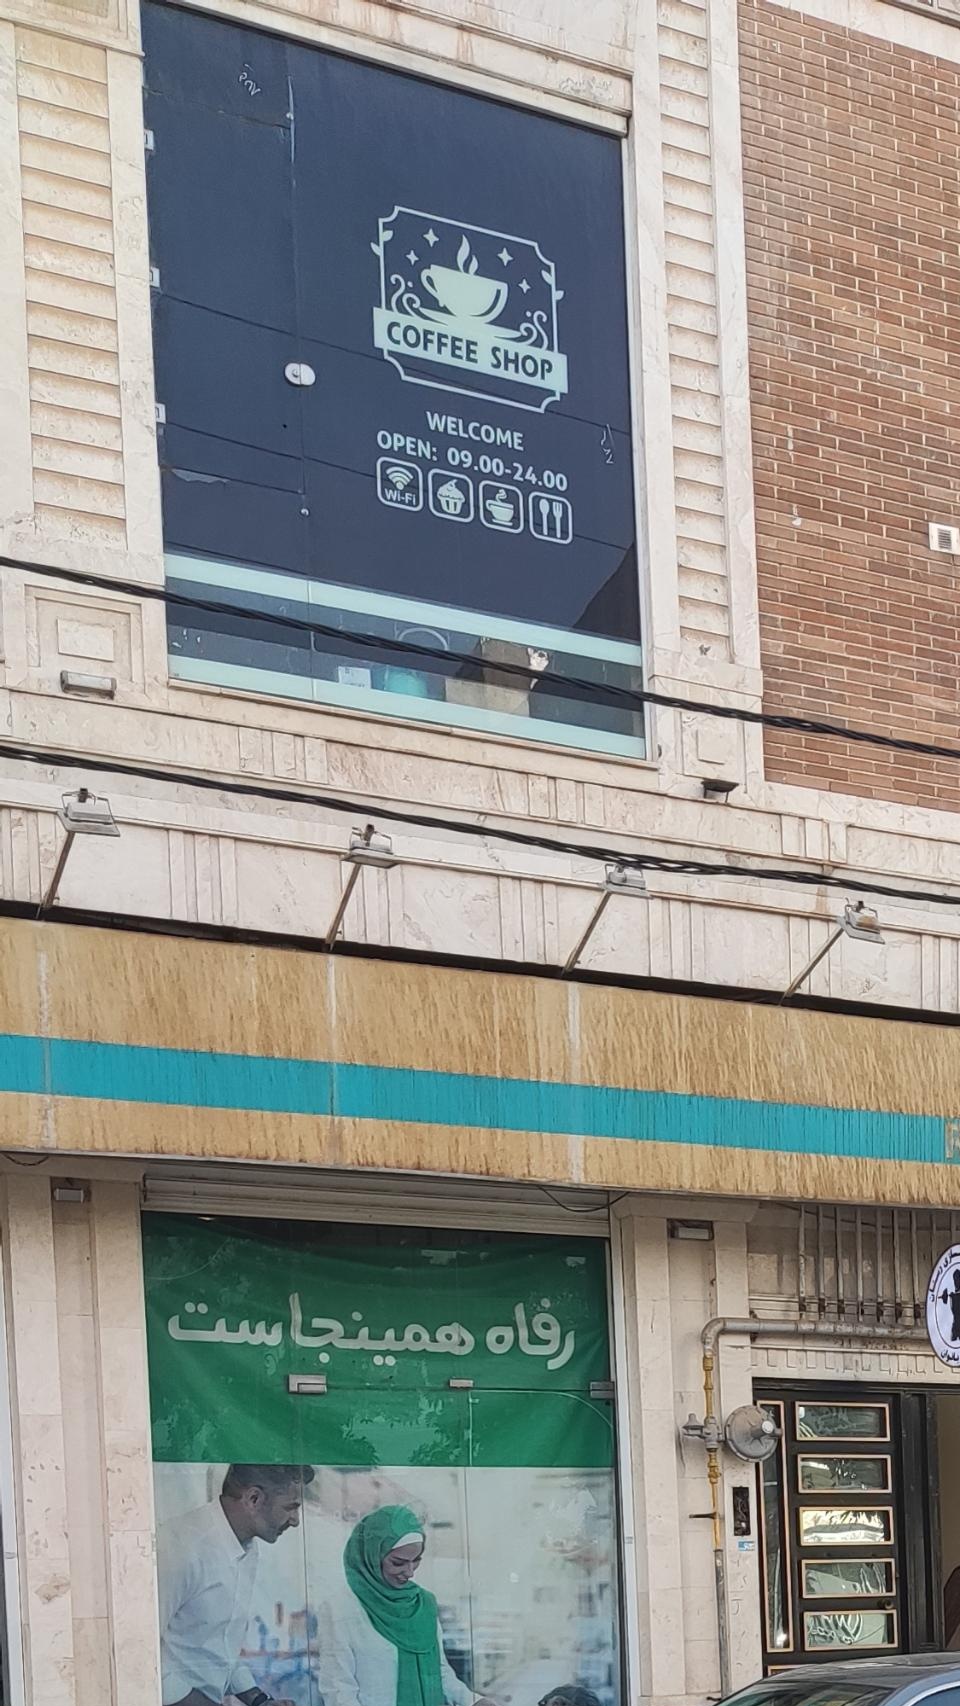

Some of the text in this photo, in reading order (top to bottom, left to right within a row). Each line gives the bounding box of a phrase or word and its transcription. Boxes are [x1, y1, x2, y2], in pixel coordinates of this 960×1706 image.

[386, 320, 554, 382] COFFEE SHOP
[376, 430, 568, 492] OPEN: 09.00-24.00
[426, 410, 524, 451] WELCOME
[384, 488, 416, 506] Wi-Fi
[167, 1292, 576, 1371] رفاه همینجاست
